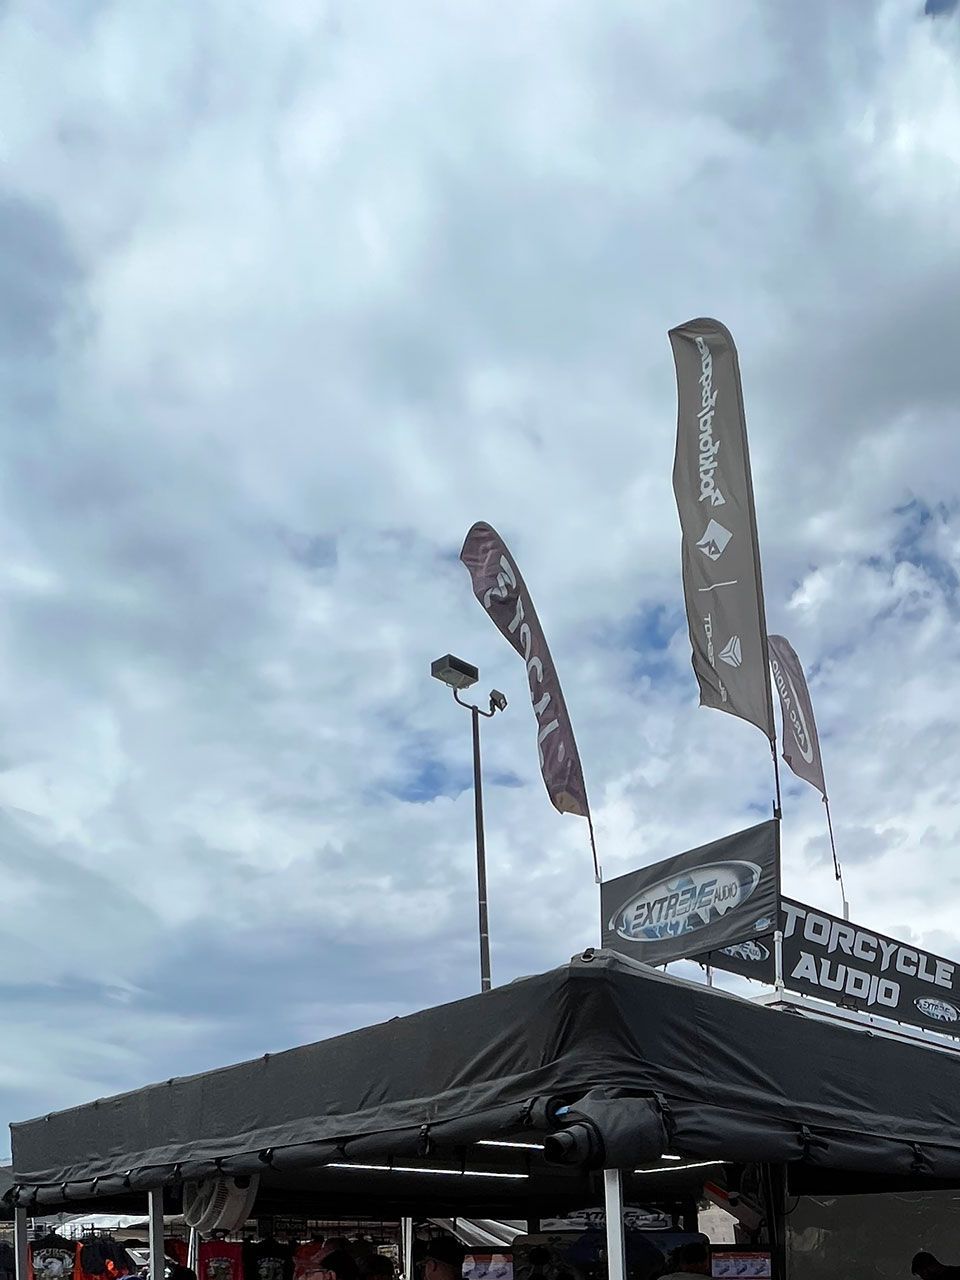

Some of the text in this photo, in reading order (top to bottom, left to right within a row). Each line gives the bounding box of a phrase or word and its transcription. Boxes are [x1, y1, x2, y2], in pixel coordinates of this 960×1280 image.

[632, 879, 738, 930] EXTREME AUDIO
[782, 902, 955, 990] TORCYCLE
[791, 951, 900, 1009] AUDIO
